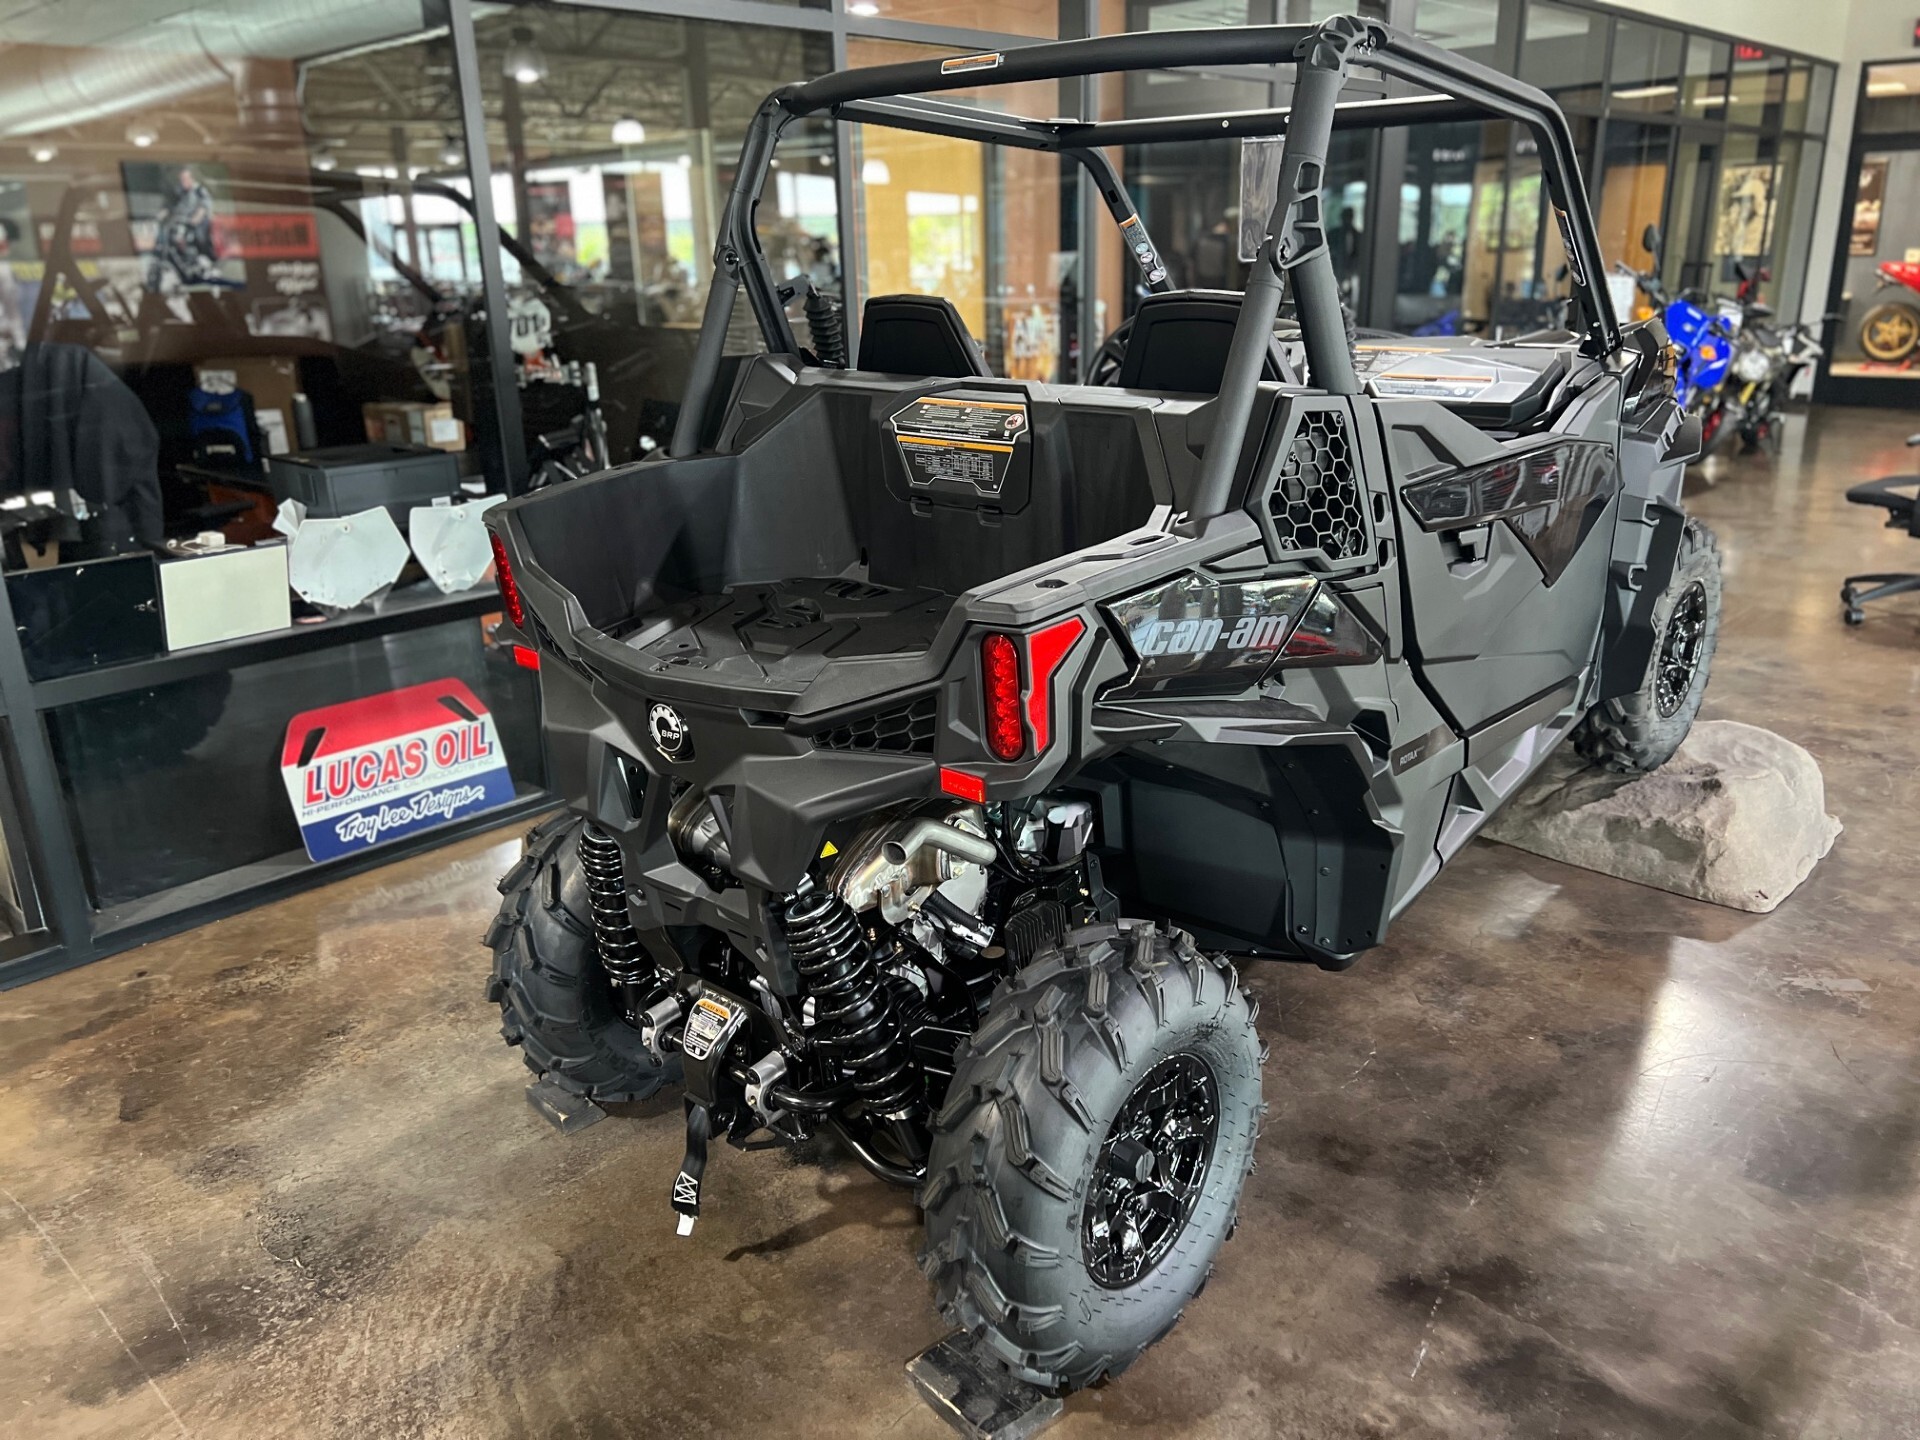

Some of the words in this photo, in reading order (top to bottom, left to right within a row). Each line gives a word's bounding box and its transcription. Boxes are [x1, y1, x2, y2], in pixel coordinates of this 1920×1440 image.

[1142, 614, 1289, 656] can-am
[661, 729, 680, 740] BRP
[303, 738, 427, 808] LUCAS
[433, 722, 494, 769] OIL
[302, 784, 400, 818] HI-PERFORMANCE
[336, 813, 377, 843] Troy
[379, 806, 410, 830] Lee
[410, 786, 484, 819] Designs
